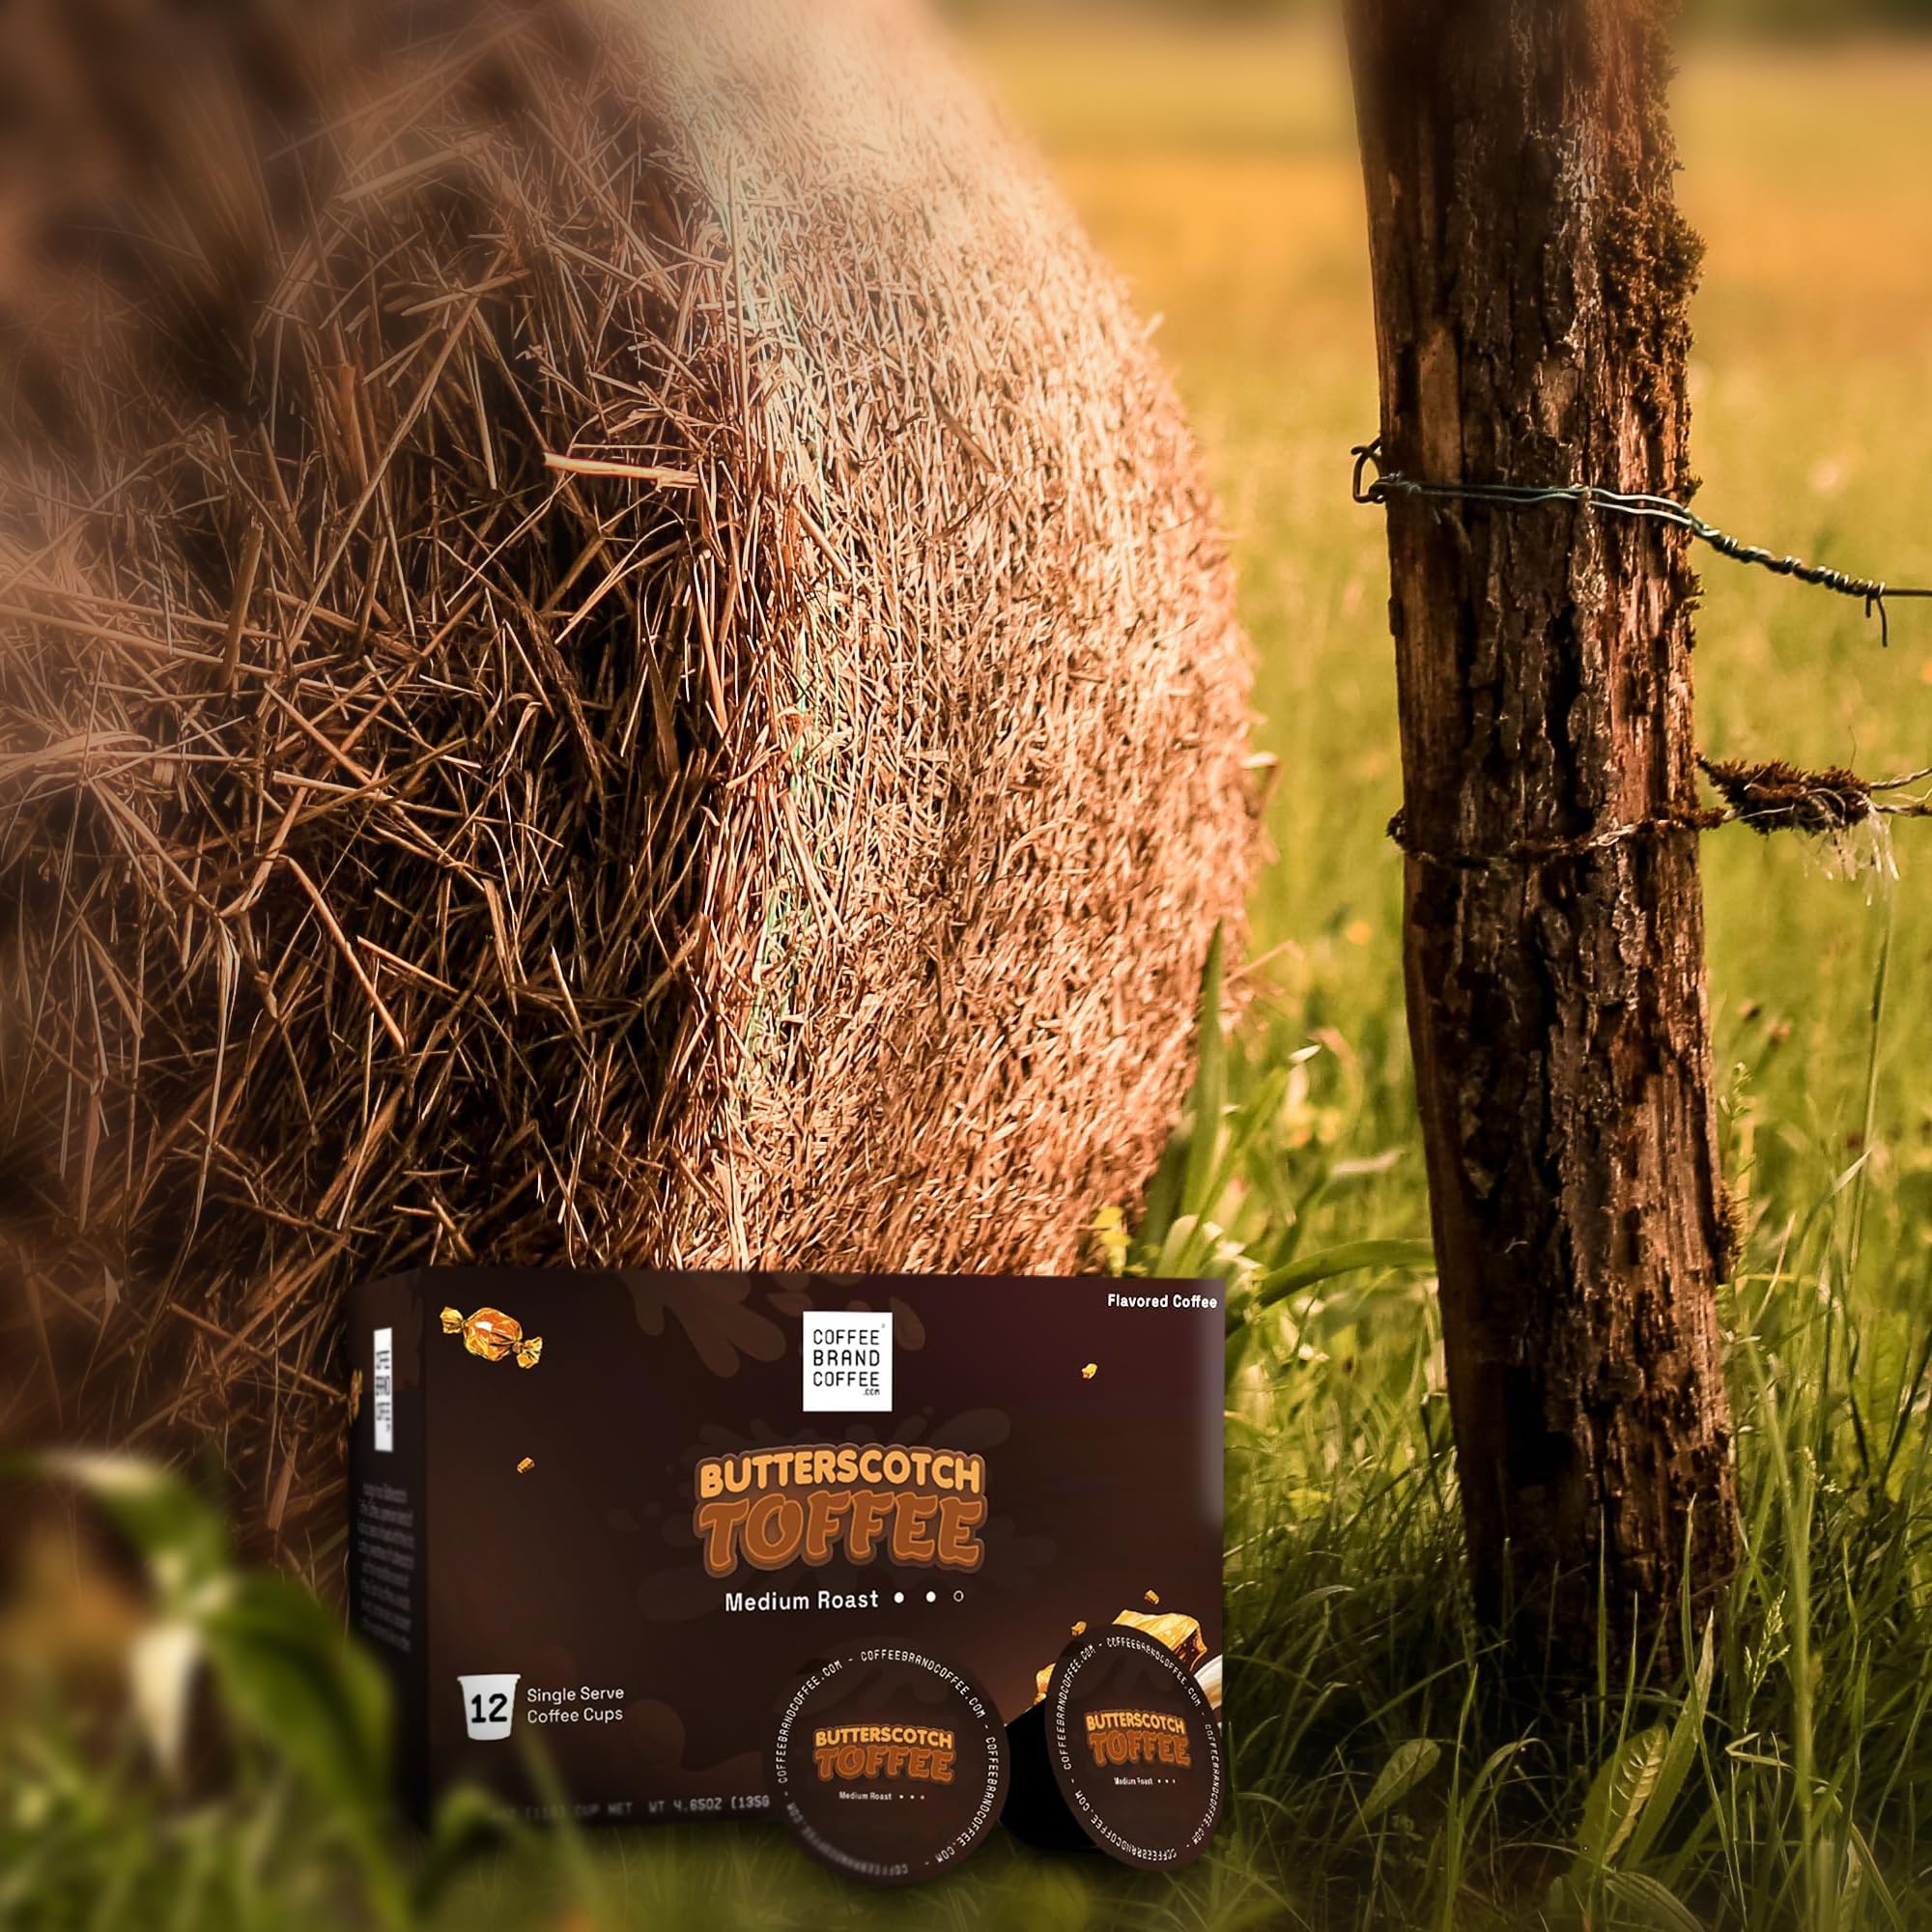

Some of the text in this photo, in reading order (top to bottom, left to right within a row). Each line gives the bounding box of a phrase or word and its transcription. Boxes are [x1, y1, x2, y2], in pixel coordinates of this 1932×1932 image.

[1107, 1293, 1218, 1309] Flavored Coffee
[813, 1329, 880, 1345] COFFEE
[813, 1350, 880, 1367] BRAND
[813, 1371, 880, 1387] COFFEE
[698, 1448, 981, 1499] BUTTERSCOTCH
[697, 1490, 983, 1573] TOFFEE
[724, 1590, 879, 1611] Medium Roast
[526, 1686, 625, 1705] Single Serve
[861, 1649, 986, 1719] COFFEEBRANDCOFFEE.COM
[471, 1693, 509, 1723] 12
[526, 1707, 623, 1724] Coffee Cups
[1055, 1644, 1096, 1771] COFFEEBRANDCOFFEE.COM
[775, 1660, 842, 1785] COFFEEBRANDCOFFEE.COM
[1086, 1712, 1186, 1735] BUTTERSCOTCH
[815, 1726, 952, 1749] BUTTERSCOTCH
[1089, 1730, 1191, 1767] TOFFEE
[814, 1745, 954, 1781] TOFFEE
[838, 1791, 892, 1801] Medium Roast
[935, 1736, 999, 1863] COFFEEBRANDCOFFEE.COM
[607, 1801, 634, 1816] NET
[648, 1800, 666, 1813] WT
